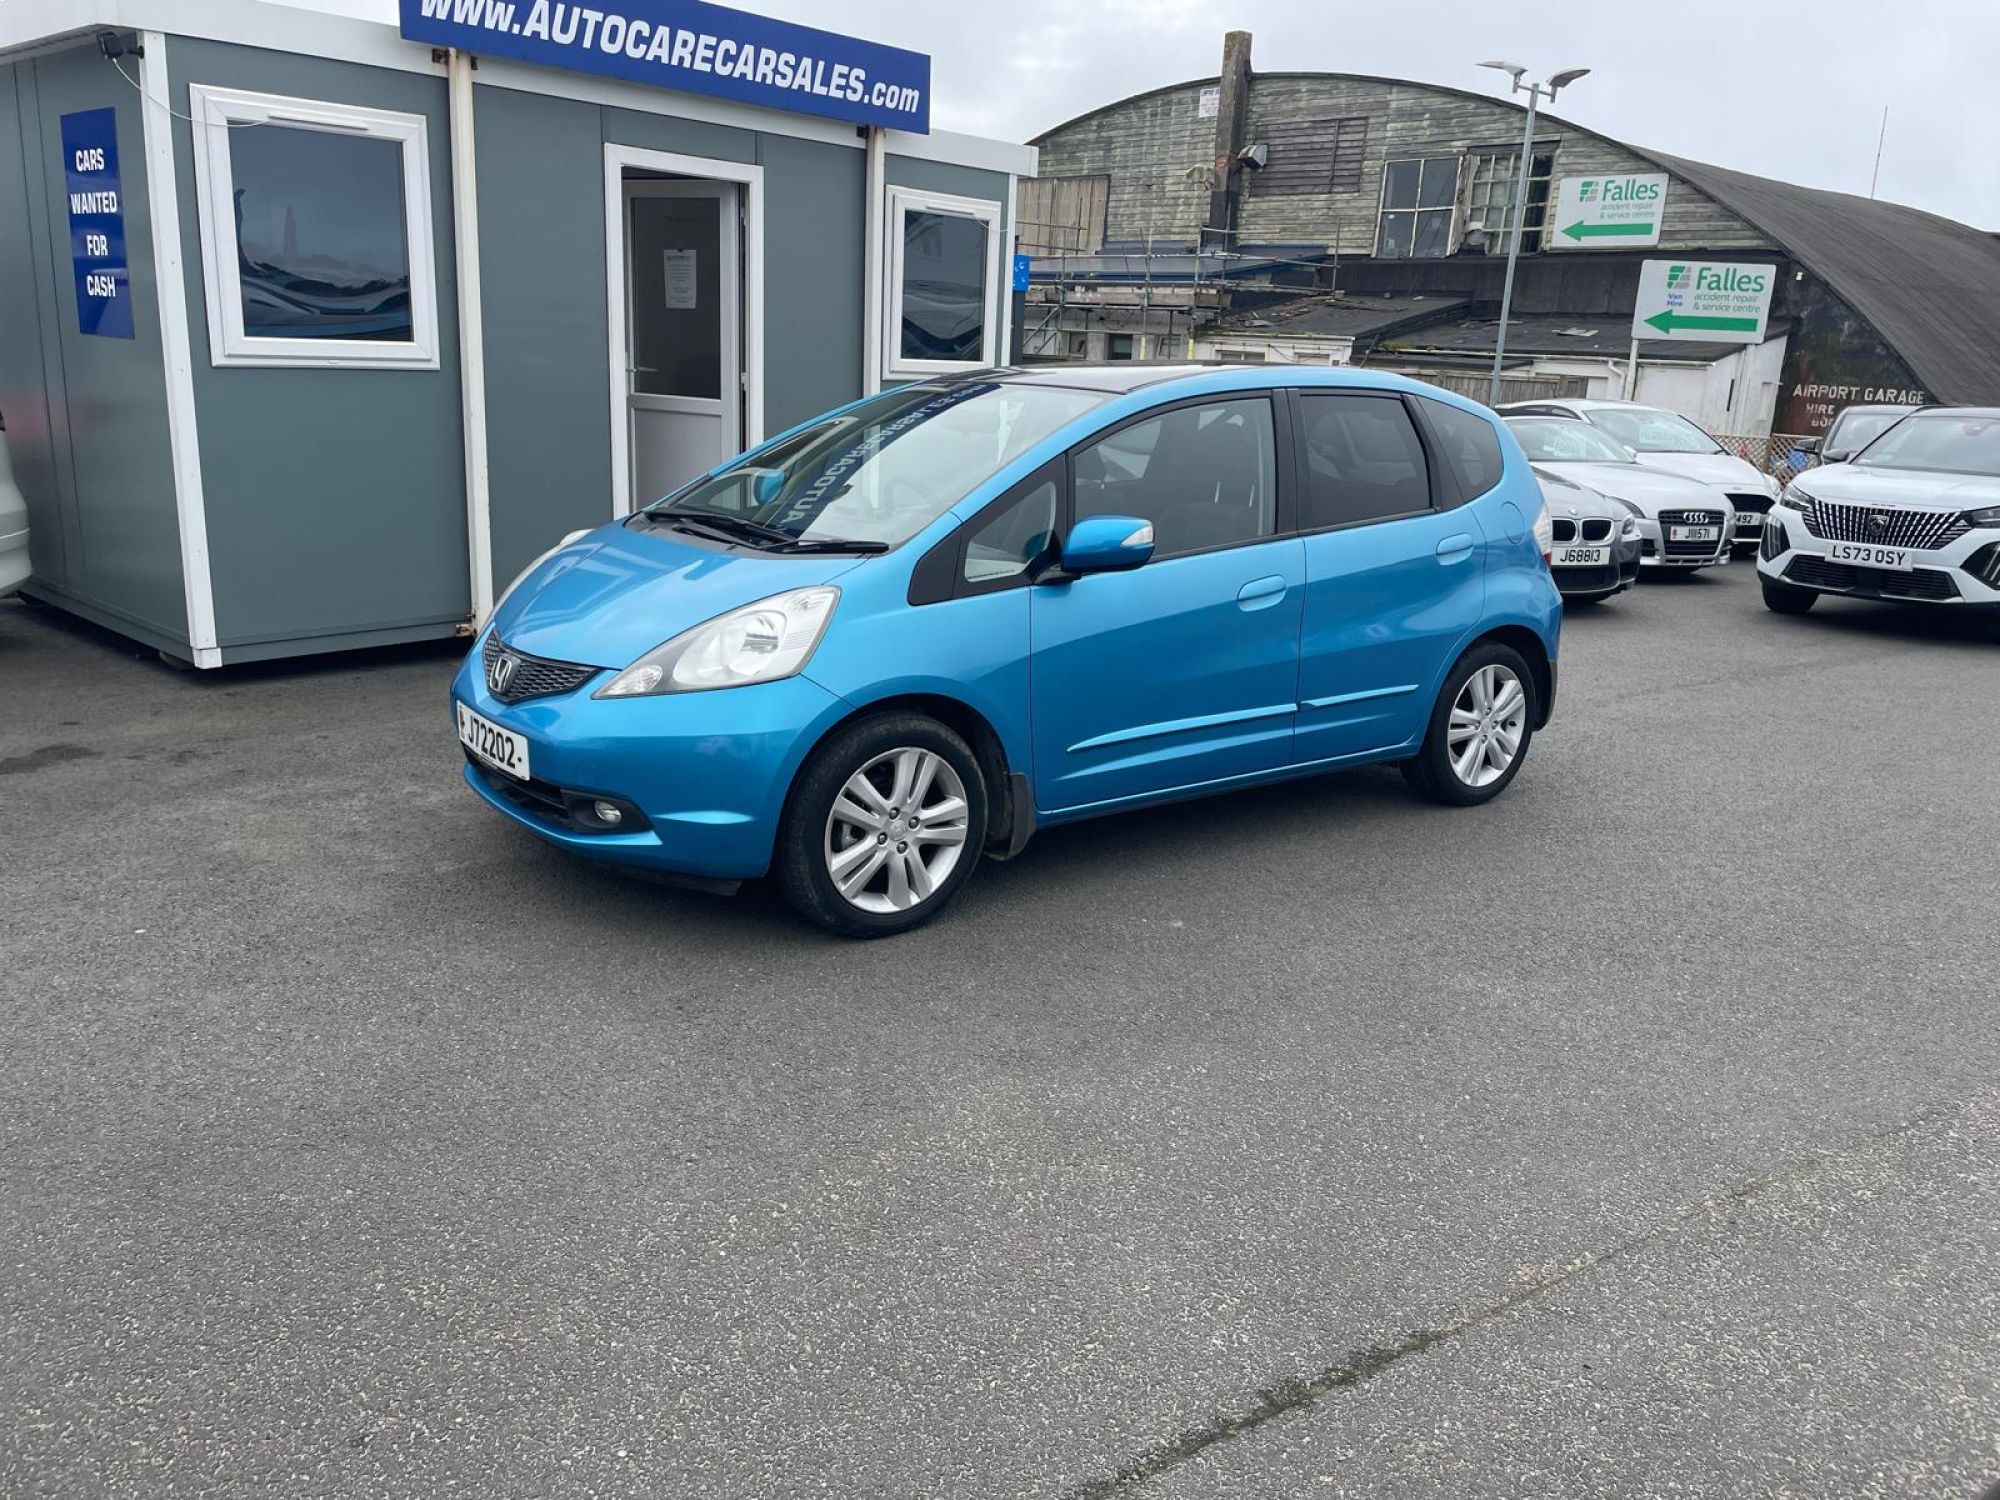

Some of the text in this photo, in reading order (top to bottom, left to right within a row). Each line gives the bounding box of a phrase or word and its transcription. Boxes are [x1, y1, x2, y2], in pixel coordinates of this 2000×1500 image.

[420, 0, 920, 114] www.AUTOCARECARSALES.com
[75, 148, 105, 172] CARS
[1602, 179, 1659, 201] Falles
[70, 191, 117, 214] WANTED
[86, 235, 108, 256] FOR
[86, 275, 116, 297] CASH
[1696, 267, 1765, 292] Falles
[1694, 293, 1759, 303] accident repair
[1701, 303, 1731, 312] service
[1733, 304, 1761, 312] centre
[1792, 383, 1925, 405] AIRPORT GARAGE
[1806, 403, 1836, 415] HIRE
[1560, 549, 1601, 562] J68813
[1832, 545, 1906, 566] LS73 OSY
[468, 715, 516, 769] J72202
